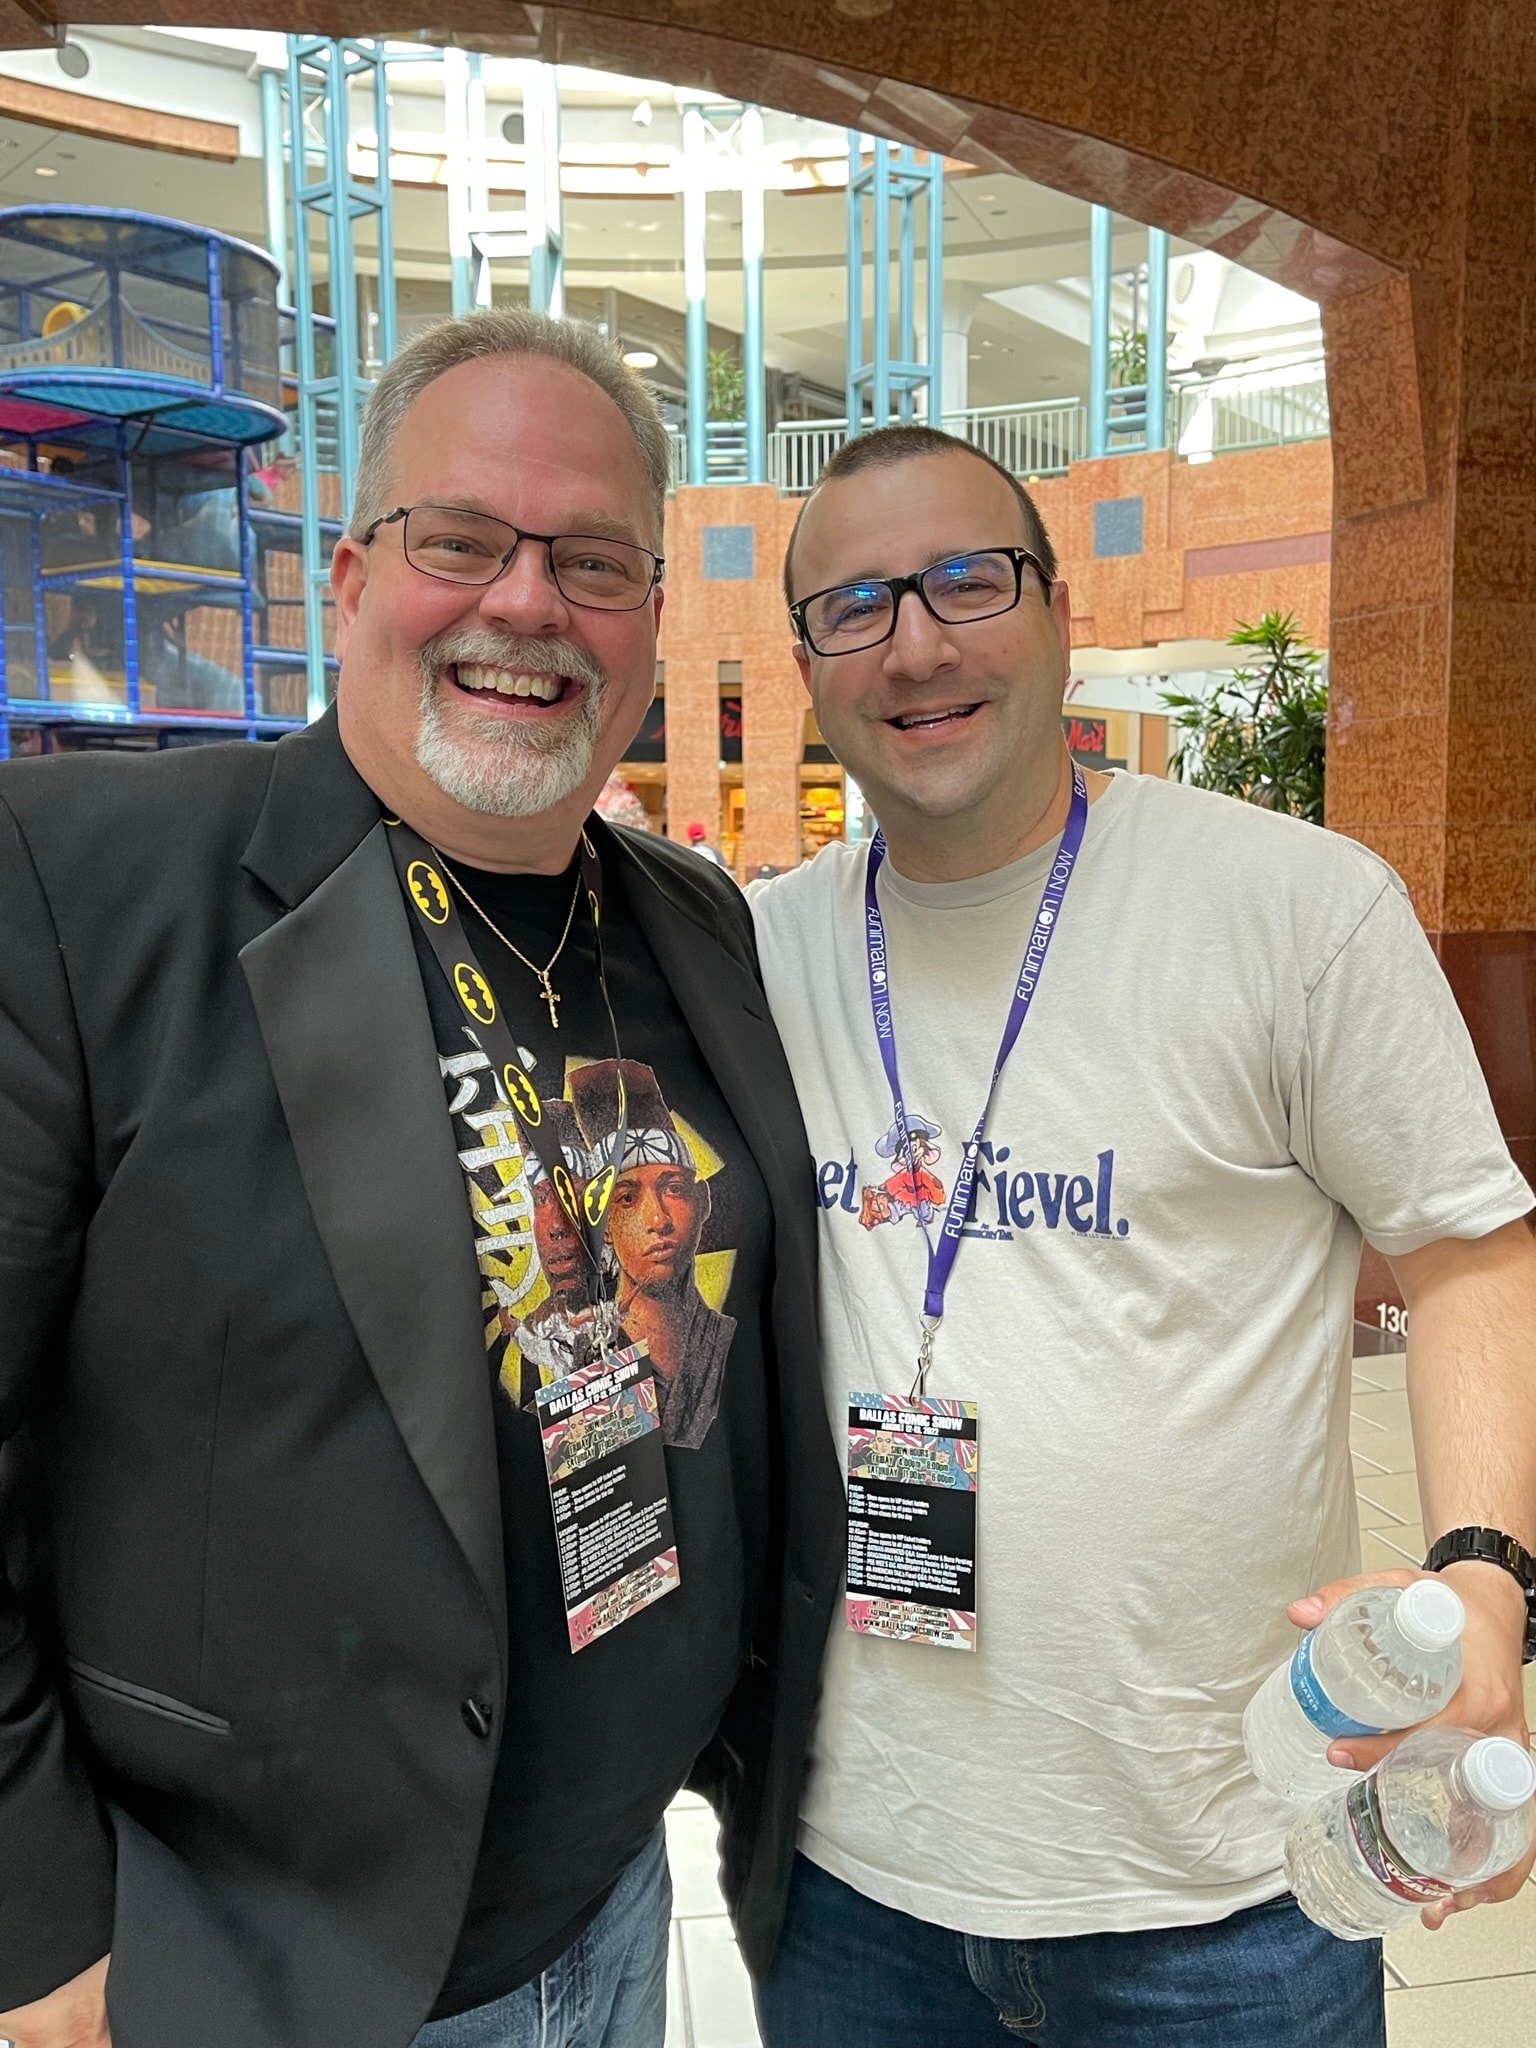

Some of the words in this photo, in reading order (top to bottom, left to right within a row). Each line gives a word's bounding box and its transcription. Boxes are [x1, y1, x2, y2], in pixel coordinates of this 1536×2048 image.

[1049, 849, 1075, 890] NOW
[874, 1001, 893, 1039] NOW
[815, 1146, 860, 1213] et
[549, 1387, 584, 1416] DALLAS
[584, 1373, 613, 1398] COMIC
[613, 1360, 639, 1384] SHOW
[859, 1408, 896, 1423] DALLAS
[898, 1412, 930, 1426] COMIC
[932, 1416, 962, 1430] SHOW
[881, 1422, 903, 1431] AUGUST
[923, 1427, 938, 1435] 2022
